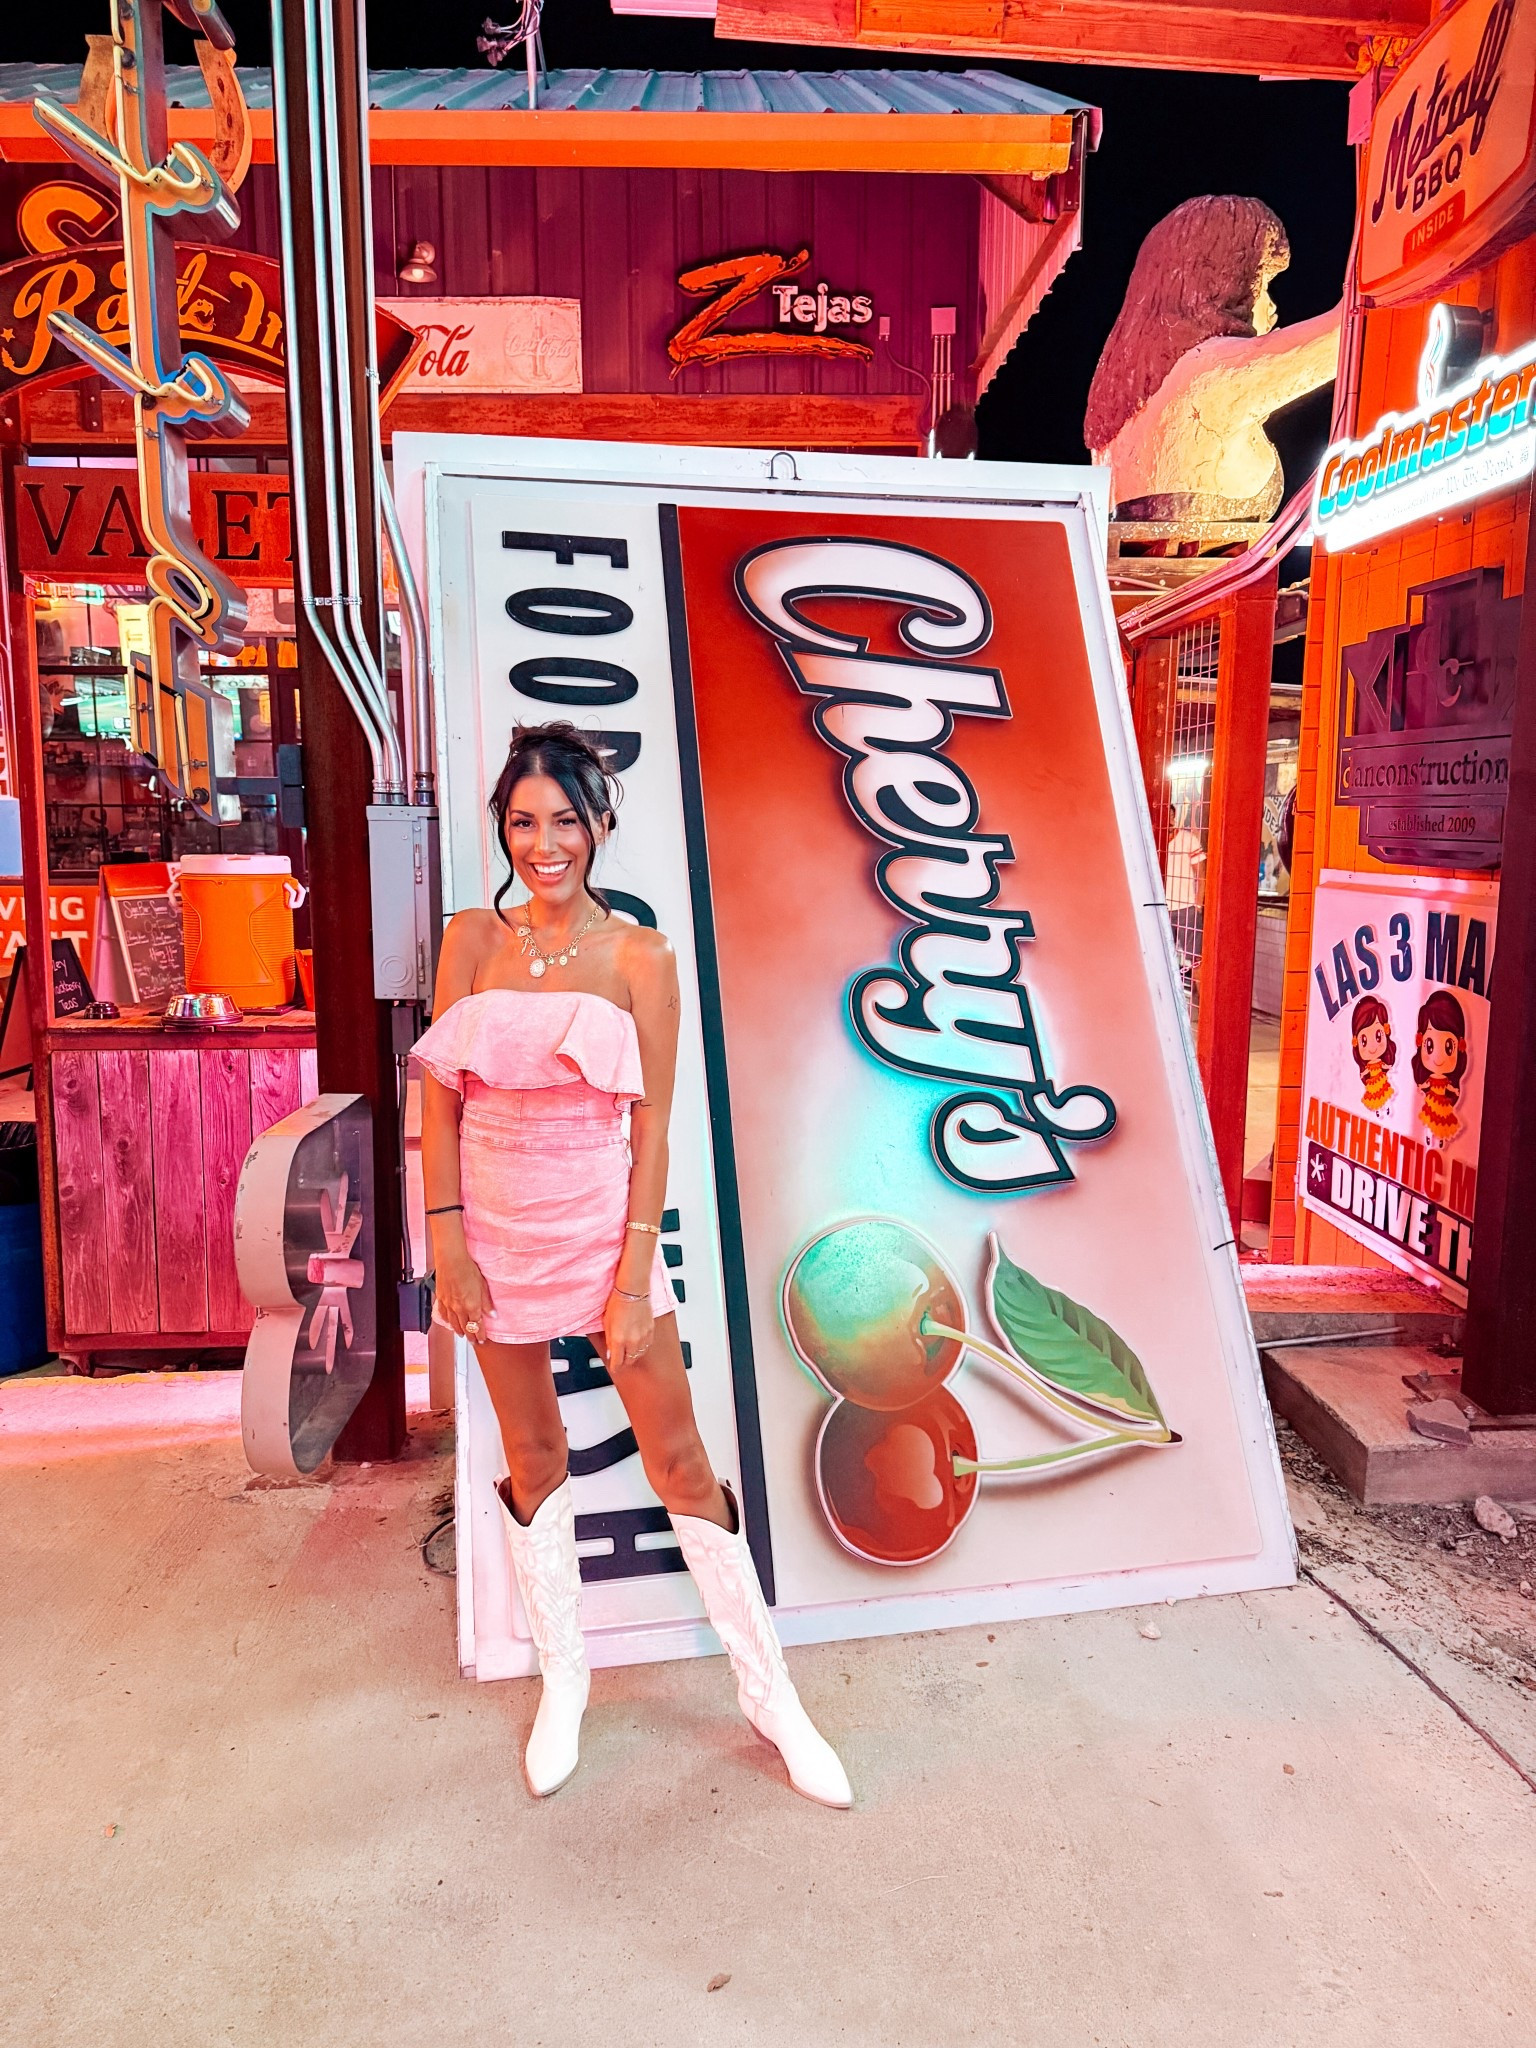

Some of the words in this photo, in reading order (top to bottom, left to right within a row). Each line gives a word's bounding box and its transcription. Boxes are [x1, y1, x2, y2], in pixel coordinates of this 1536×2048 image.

[1411, 202, 1455, 251] INSIDE
[1412, 143, 1463, 214] BBQ
[669, 249, 874, 381] Z
[772, 283, 873, 333] Tejas
[733, 535, 1118, 1193] Cherry's
[1387, 816, 1445, 833] established
[1446, 816, 1476, 834] 2009
[1314, 925, 1380, 1021] LAS
[1389, 912, 1412, 983] 3
[1304, 1096, 1444, 1200] AUTHENTIC
[1331, 1155, 1430, 1256] DRIVE
